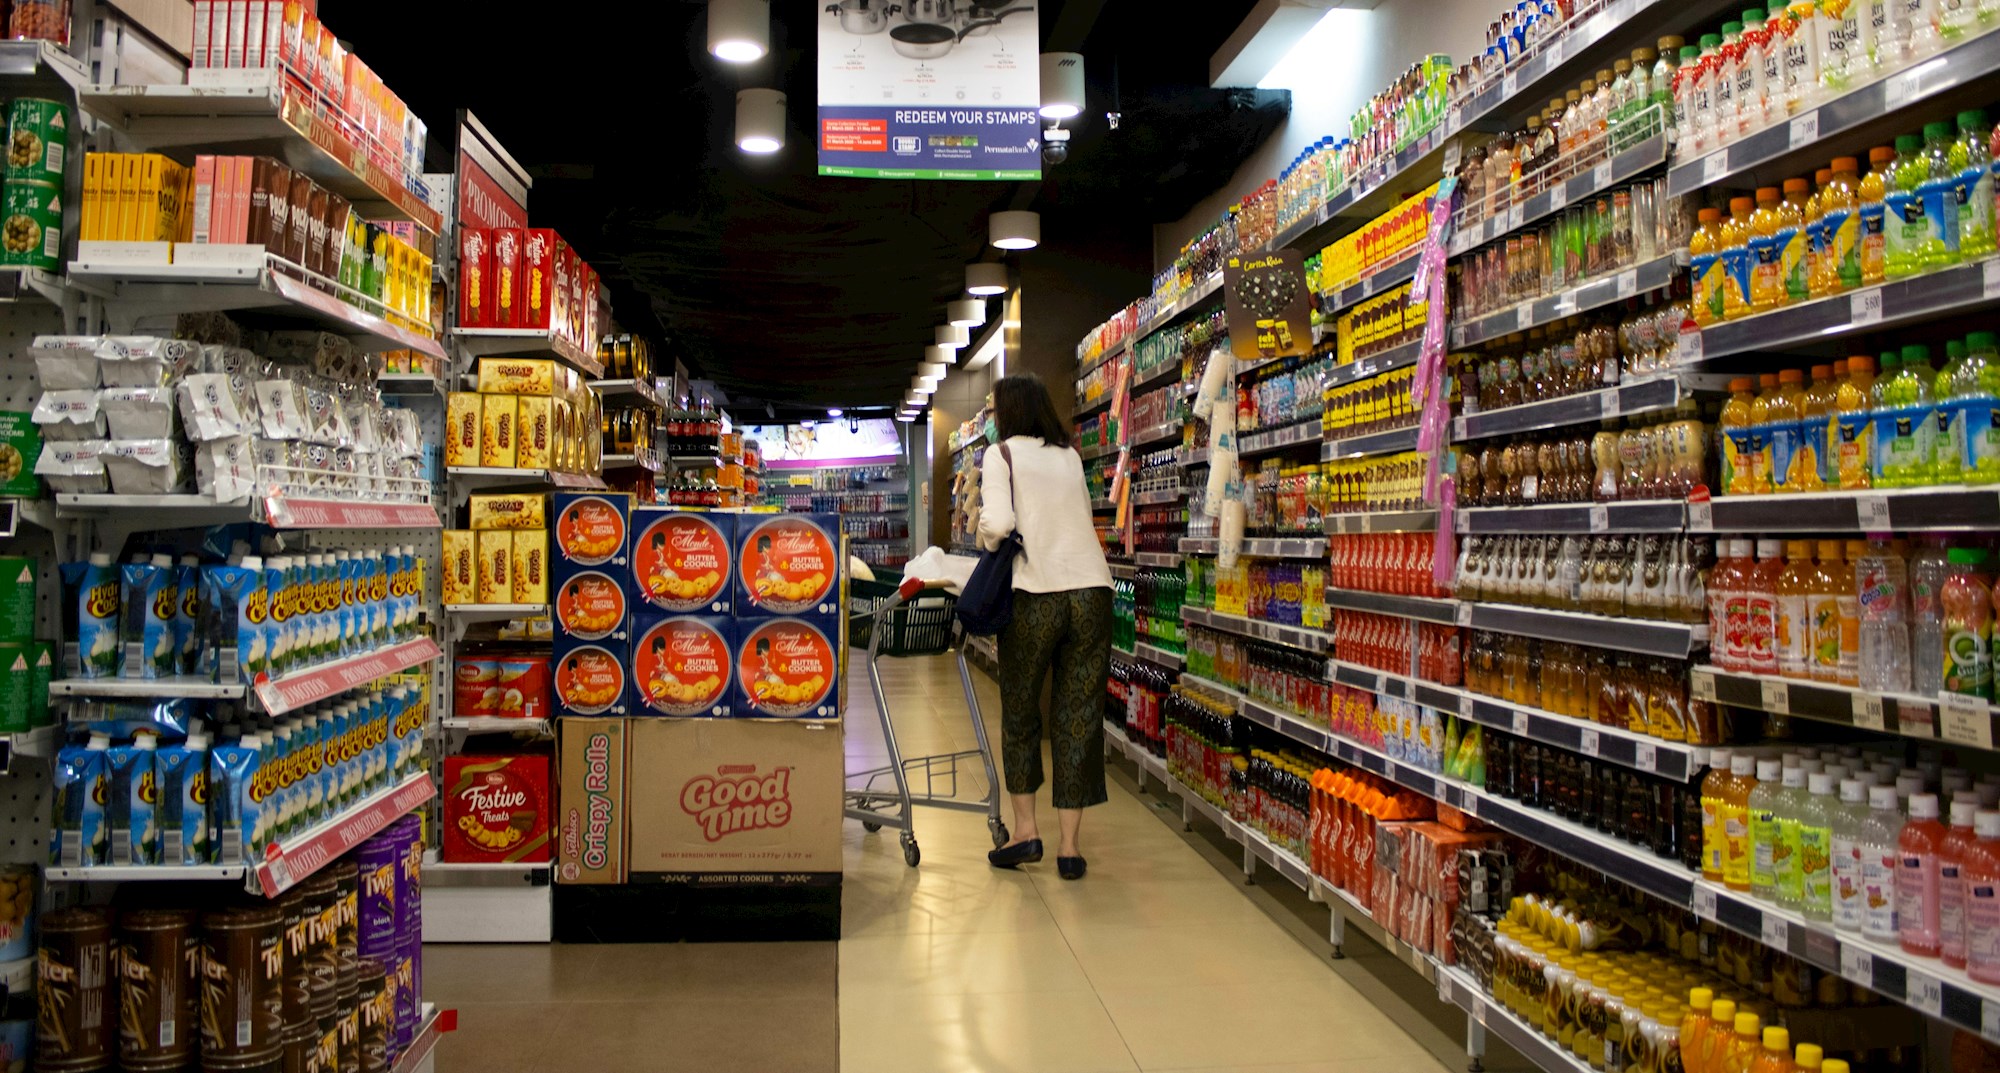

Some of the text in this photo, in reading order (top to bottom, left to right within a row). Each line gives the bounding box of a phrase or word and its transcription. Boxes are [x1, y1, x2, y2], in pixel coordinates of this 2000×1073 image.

[895, 111, 1036, 124] REDEEM YOUR STAMPS
[985, 145, 1028, 154] PermataBank
[1244, 256, 1283, 271] Cerita Rasa
[499, 366, 533, 376] ROYAL
[467, 411, 475, 449] ROYAL
[501, 412, 509, 449] ROYAL
[537, 414, 546, 450] ROYAL
[489, 501, 523, 511] ROYAL
[342, 508, 386, 523] PROMOTION
[673, 527, 697, 535] Danish
[778, 530, 802, 538] Danish
[672, 536, 710, 549] Monde
[777, 539, 816, 551] Monde
[461, 549, 470, 586] ROYAL
[497, 549, 506, 586] ROYAL
[532, 549, 541, 586] ROYAL
[683, 560, 718, 568] COOKIES
[789, 562, 824, 570] COOKIES
[673, 631, 697, 640] Danish
[777, 632, 801, 640] Danish
[672, 640, 711, 652] Monde
[776, 640, 814, 653] Monde
[1949, 631, 1991, 665] Q
[394, 642, 435, 666] PROMOTION
[340, 659, 388, 686] PROMOTION
[684, 664, 719, 672] COOKIES
[788, 665, 822, 673] COOKIES
[393, 781, 431, 812] PROMOTION
[461, 784, 526, 812] Festive
[682, 767, 790, 815] Good
[586, 735, 611, 869] Crispy Rolls
[481, 810, 510, 824] Treats
[700, 800, 791, 842] Time
[339, 807, 386, 847] PROMOTION
[699, 875, 774, 883] ASSORTED COOKIES
